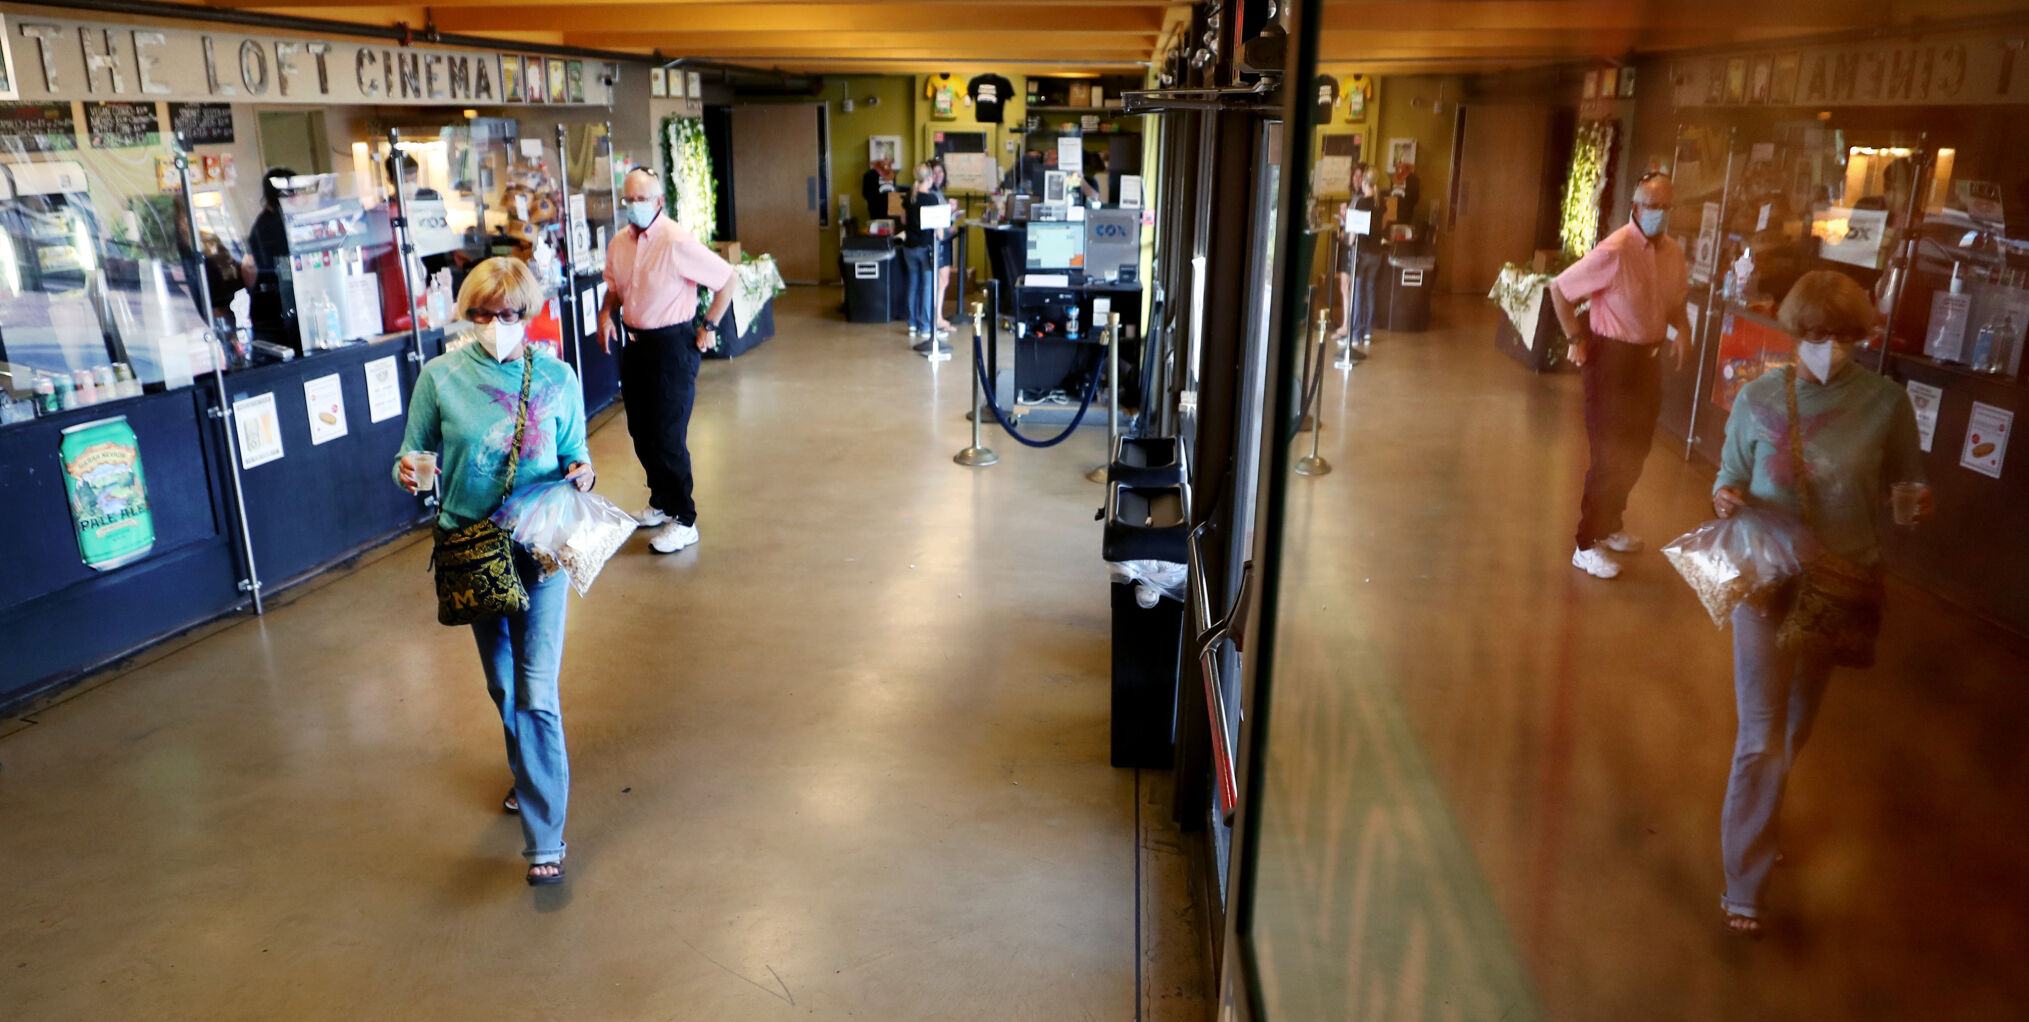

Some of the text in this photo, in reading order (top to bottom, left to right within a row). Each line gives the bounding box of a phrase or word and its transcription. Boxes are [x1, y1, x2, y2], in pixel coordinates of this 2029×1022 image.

[19, 23, 493, 99] THE LOFT CINEMA
[1096, 224, 1127, 237] COX
[80, 513, 117, 531] PALE
[120, 502, 146, 519] ALE
[452, 589, 478, 609] M
